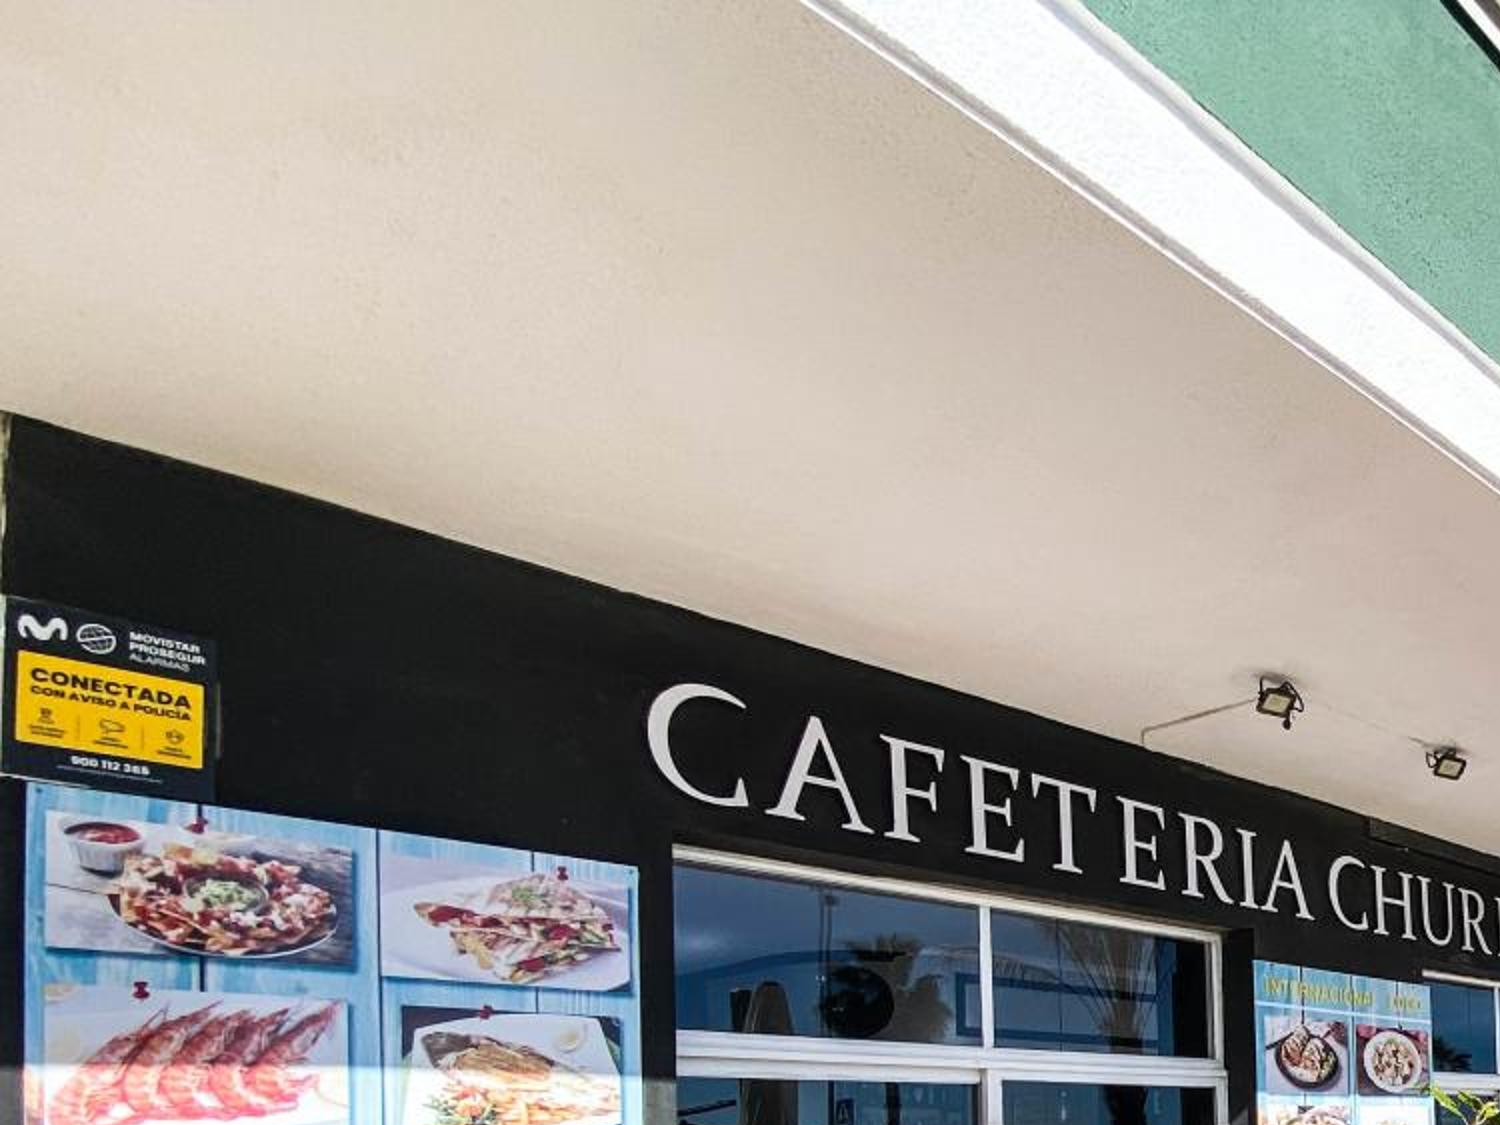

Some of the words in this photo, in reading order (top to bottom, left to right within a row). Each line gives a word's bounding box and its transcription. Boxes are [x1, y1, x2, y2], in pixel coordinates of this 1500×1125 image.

[129, 631, 200, 654] MOVISTAR
[129, 642, 206, 665] PROSEGUR
[129, 653, 190, 673] ALARMAS
[30, 684, 65, 698] CON
[69, 692, 117, 708] AVISO
[120, 701, 131, 712] A
[31, 667, 192, 709] CONECTADA
[101, 760, 120, 772] 112
[647, 682, 1315, 921] CAFETERIA
